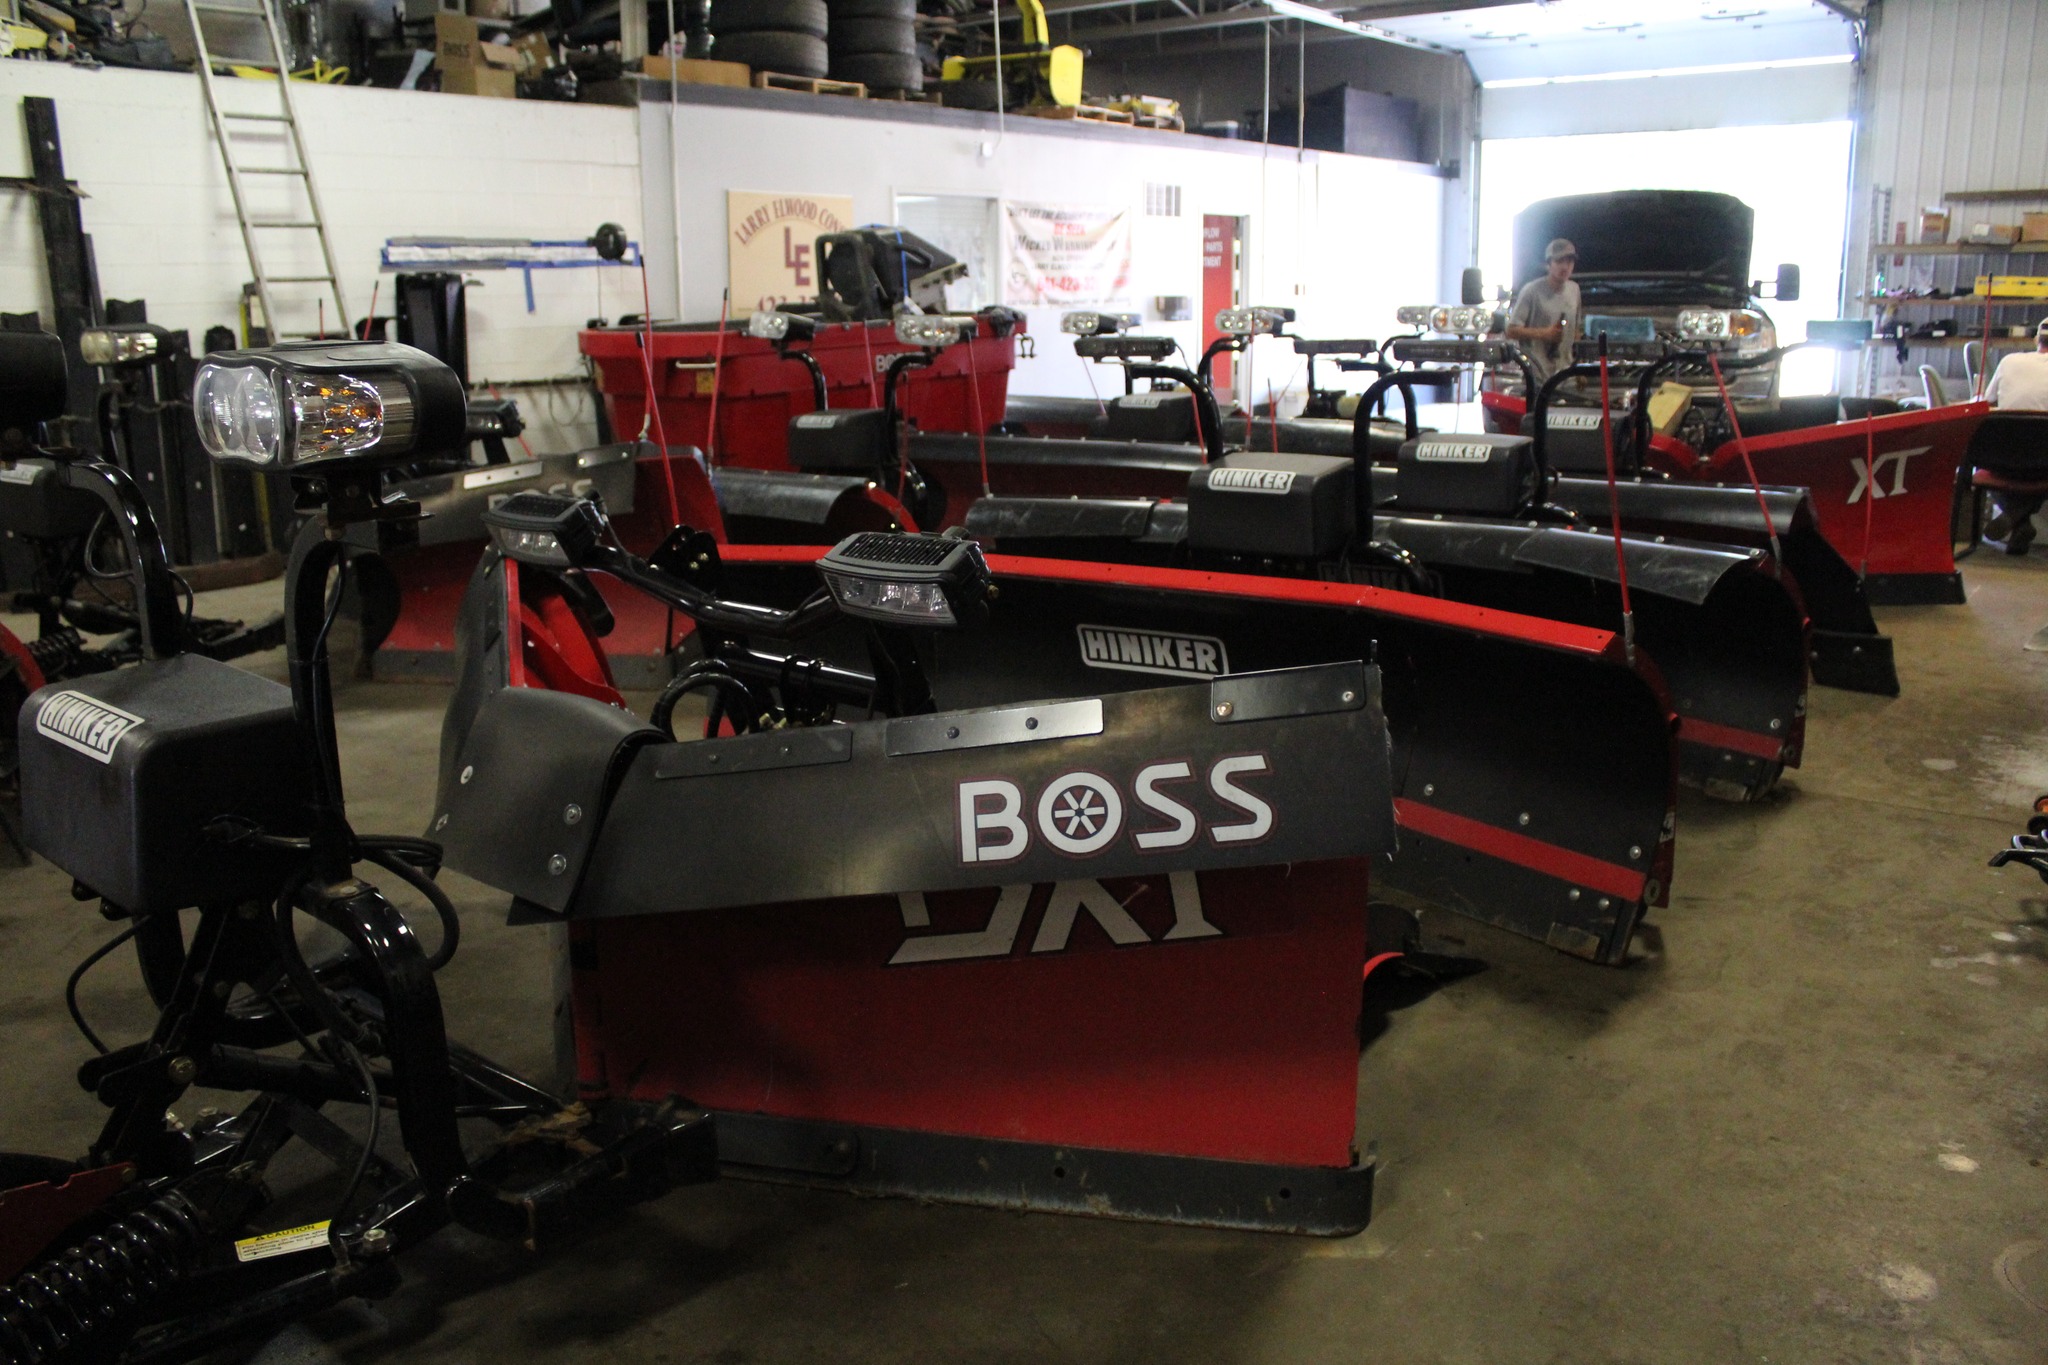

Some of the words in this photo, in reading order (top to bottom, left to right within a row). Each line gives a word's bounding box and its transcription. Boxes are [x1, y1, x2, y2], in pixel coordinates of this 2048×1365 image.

[734, 204, 770, 245] LARRY
[772, 198, 818, 221] ELWOOD
[784, 226, 811, 286] LE
[1421, 444, 1487, 459] HINIKER
[1847, 446, 1933, 504] XT
[1213, 470, 1290, 489] HINIKER
[1085, 630, 1219, 673] HINIKER
[41, 694, 130, 753] HINIKER
[960, 755, 1273, 862] BOSS
[266, 1225, 315, 1239] CAUTION
